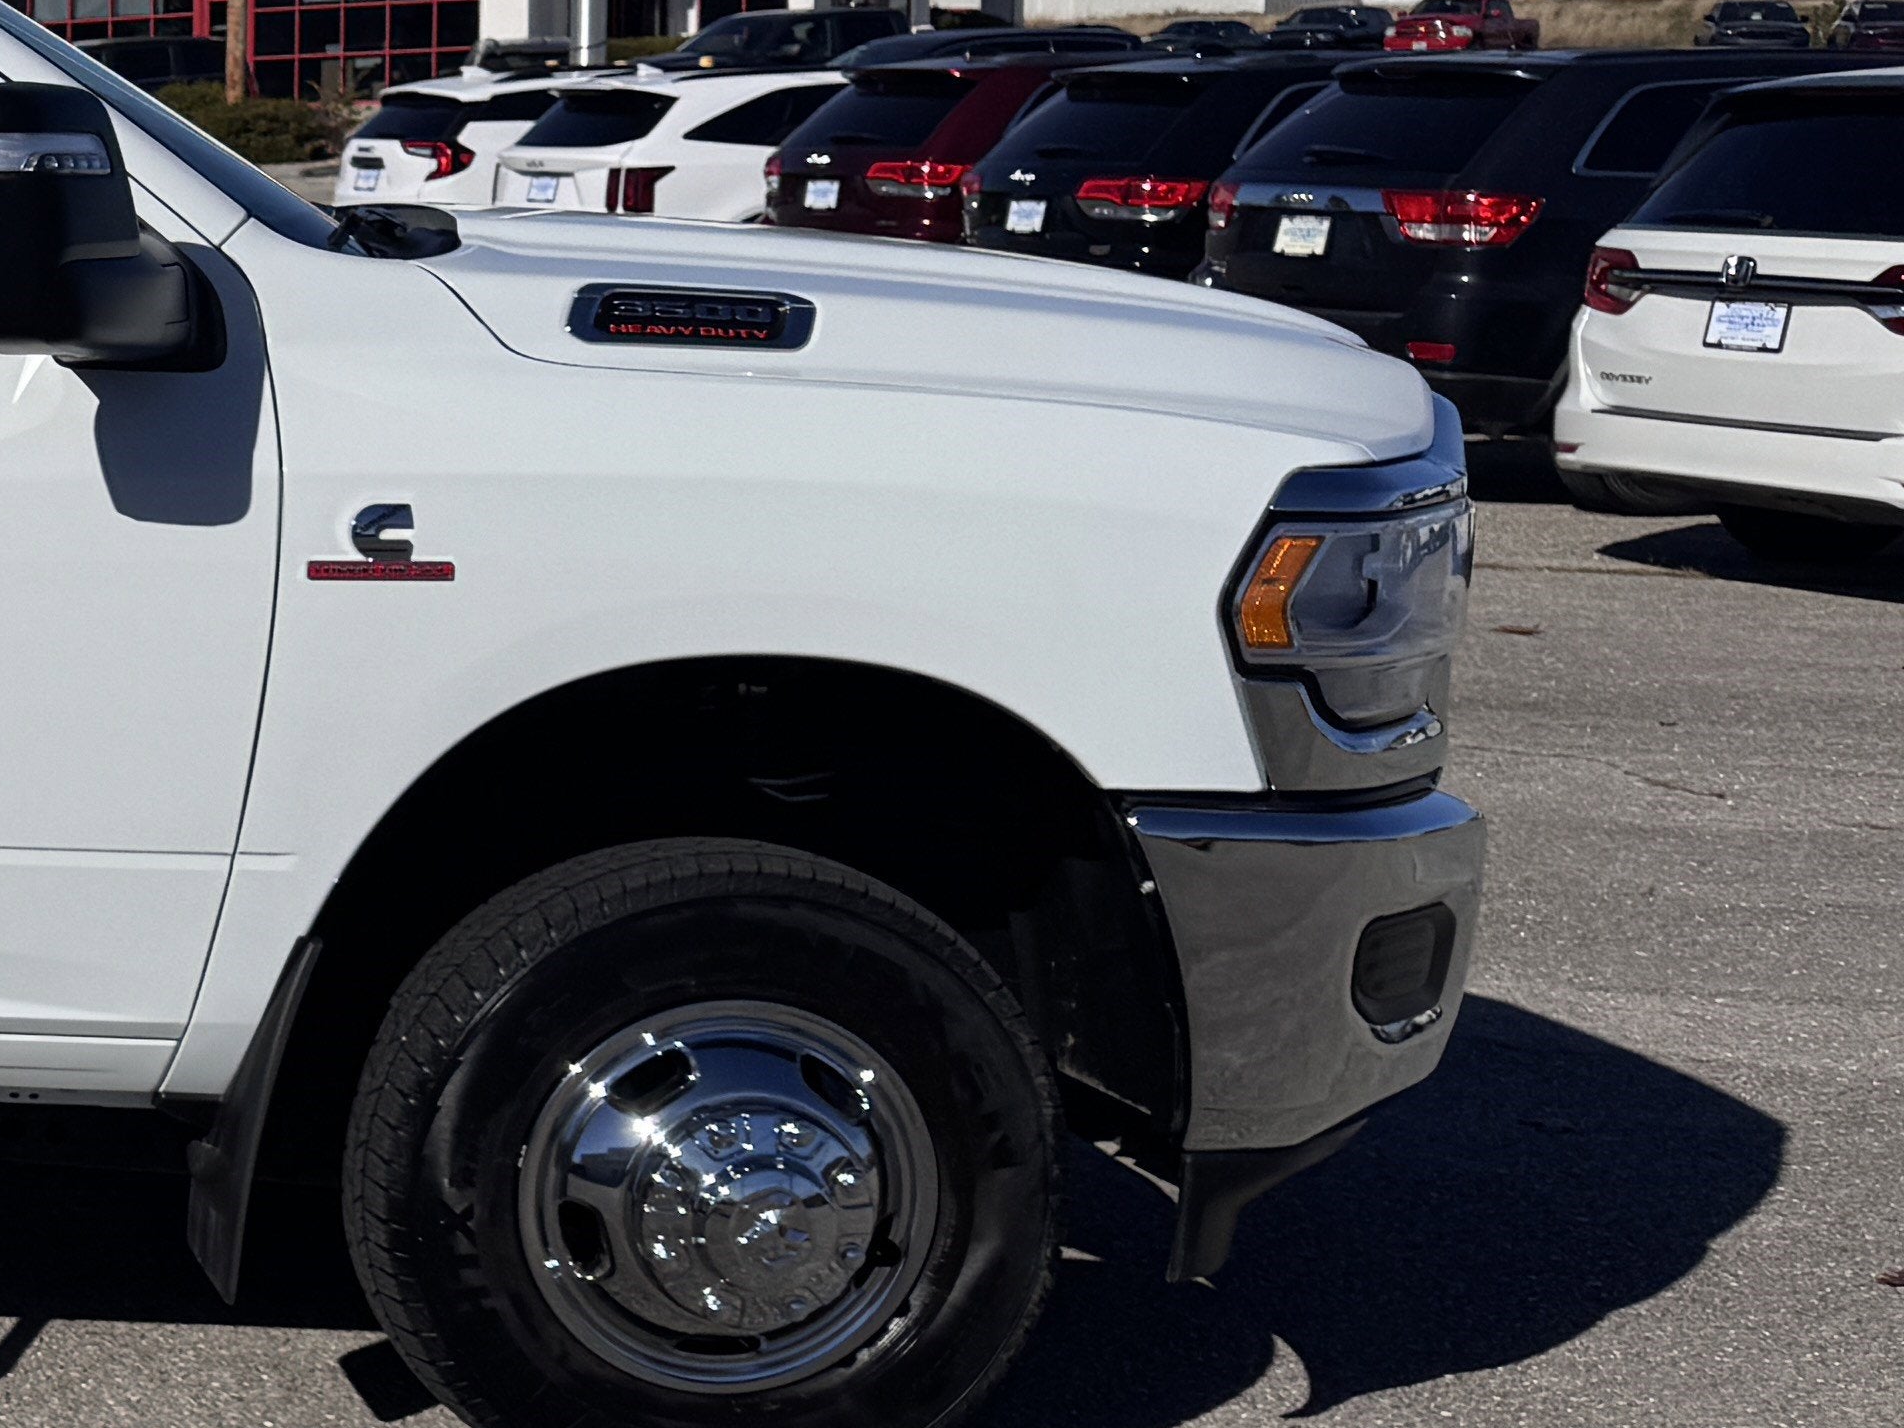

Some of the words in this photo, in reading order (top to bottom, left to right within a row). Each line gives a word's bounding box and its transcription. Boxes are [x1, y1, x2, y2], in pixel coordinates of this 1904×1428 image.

[611, 299, 773, 323] 3500
[609, 323, 694, 336] HEAVY
[699, 326, 769, 340] DUTY
